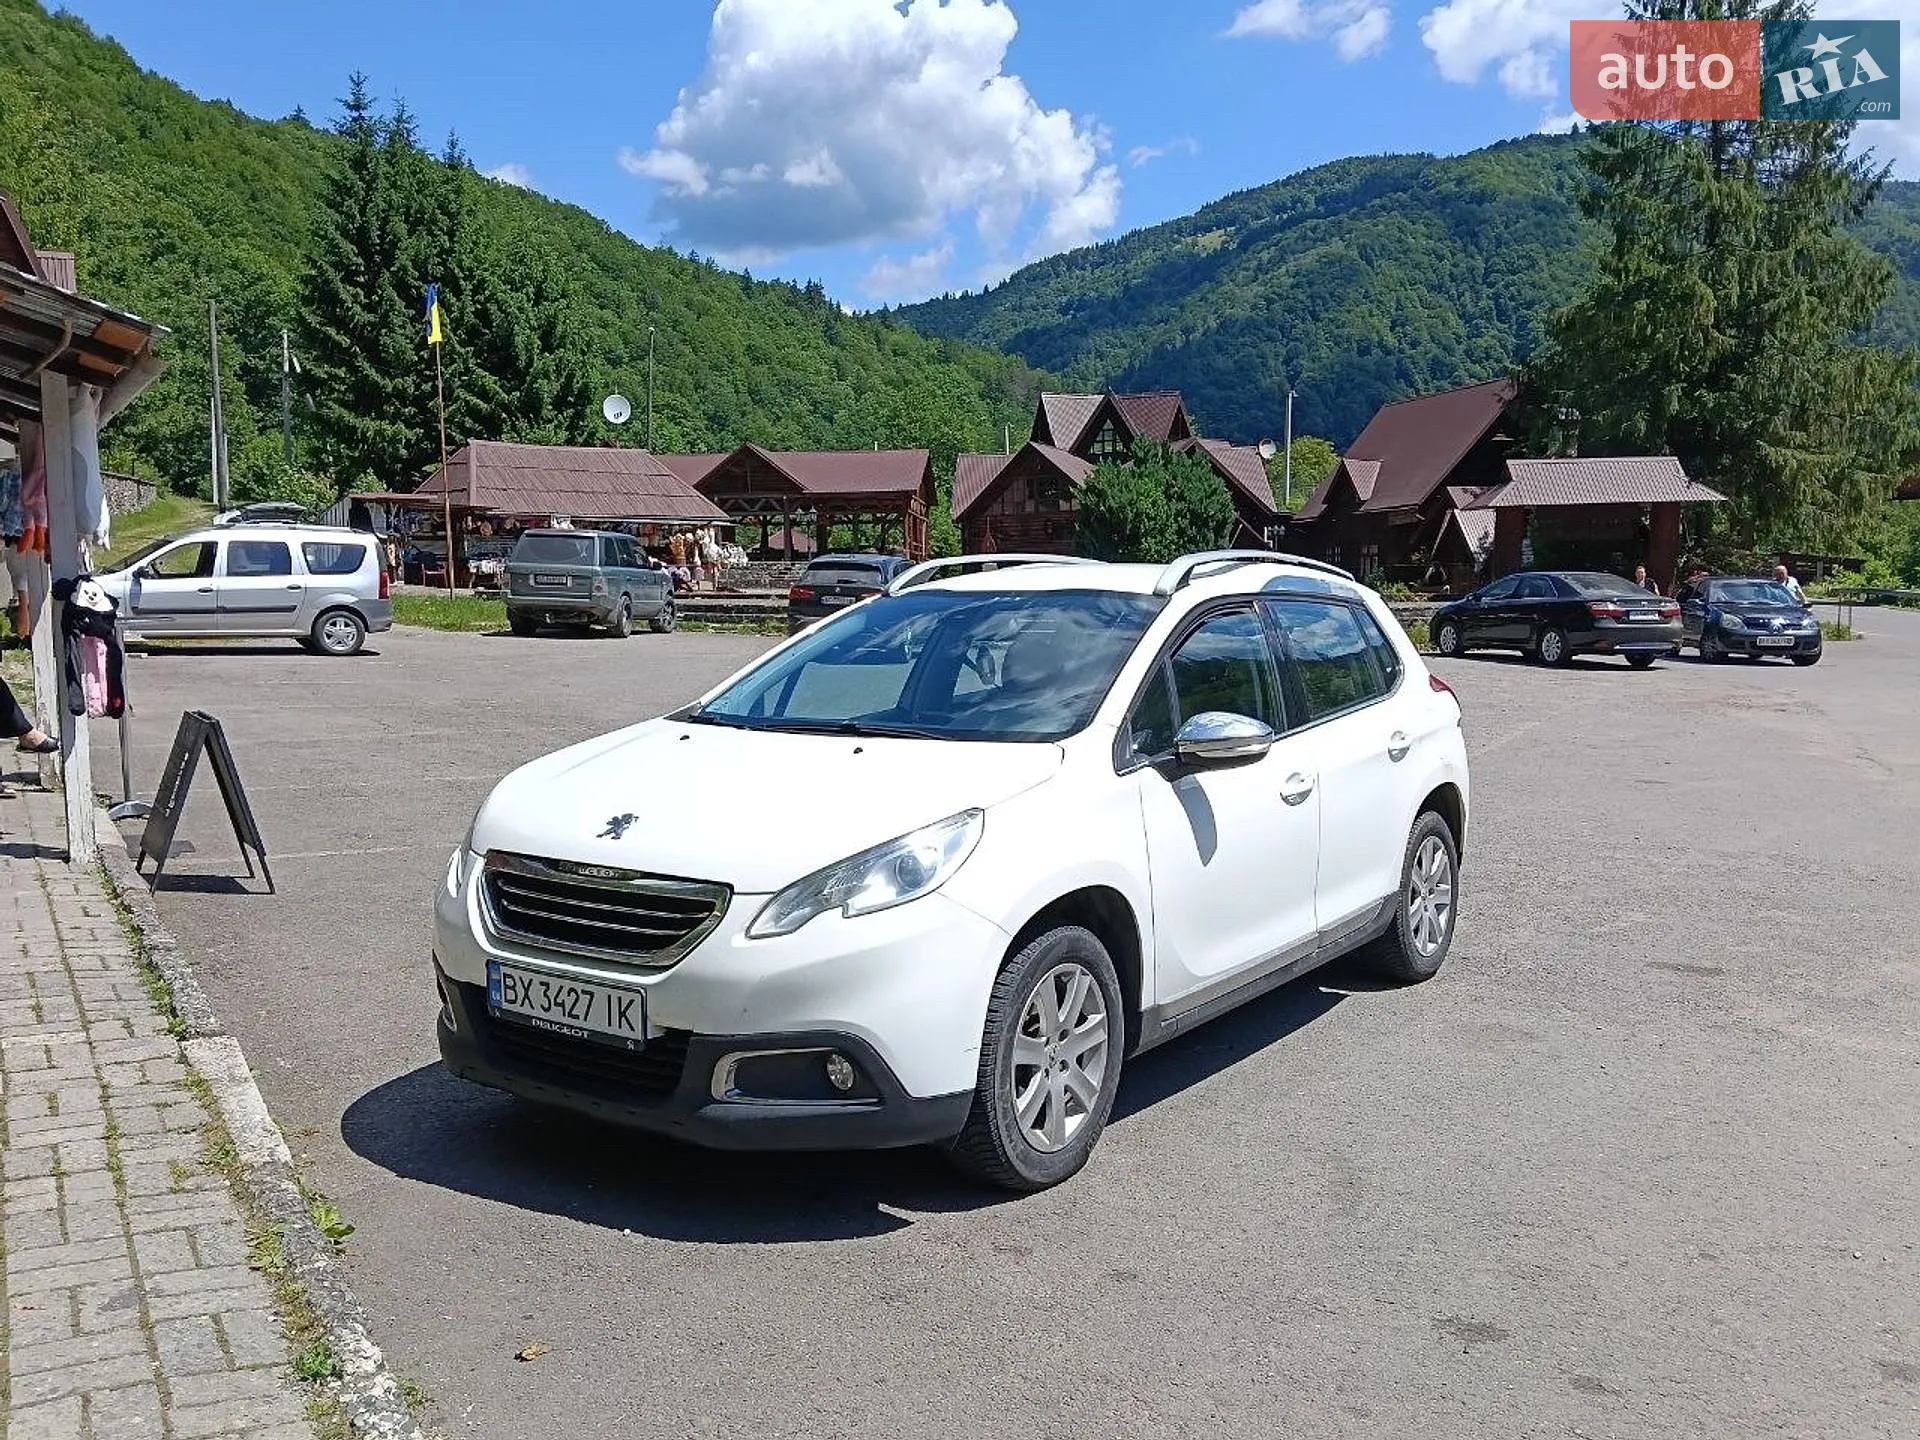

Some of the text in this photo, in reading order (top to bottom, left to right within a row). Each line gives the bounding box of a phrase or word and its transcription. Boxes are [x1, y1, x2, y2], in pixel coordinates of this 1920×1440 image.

[502, 972, 636, 1032] BX 3427 IK
